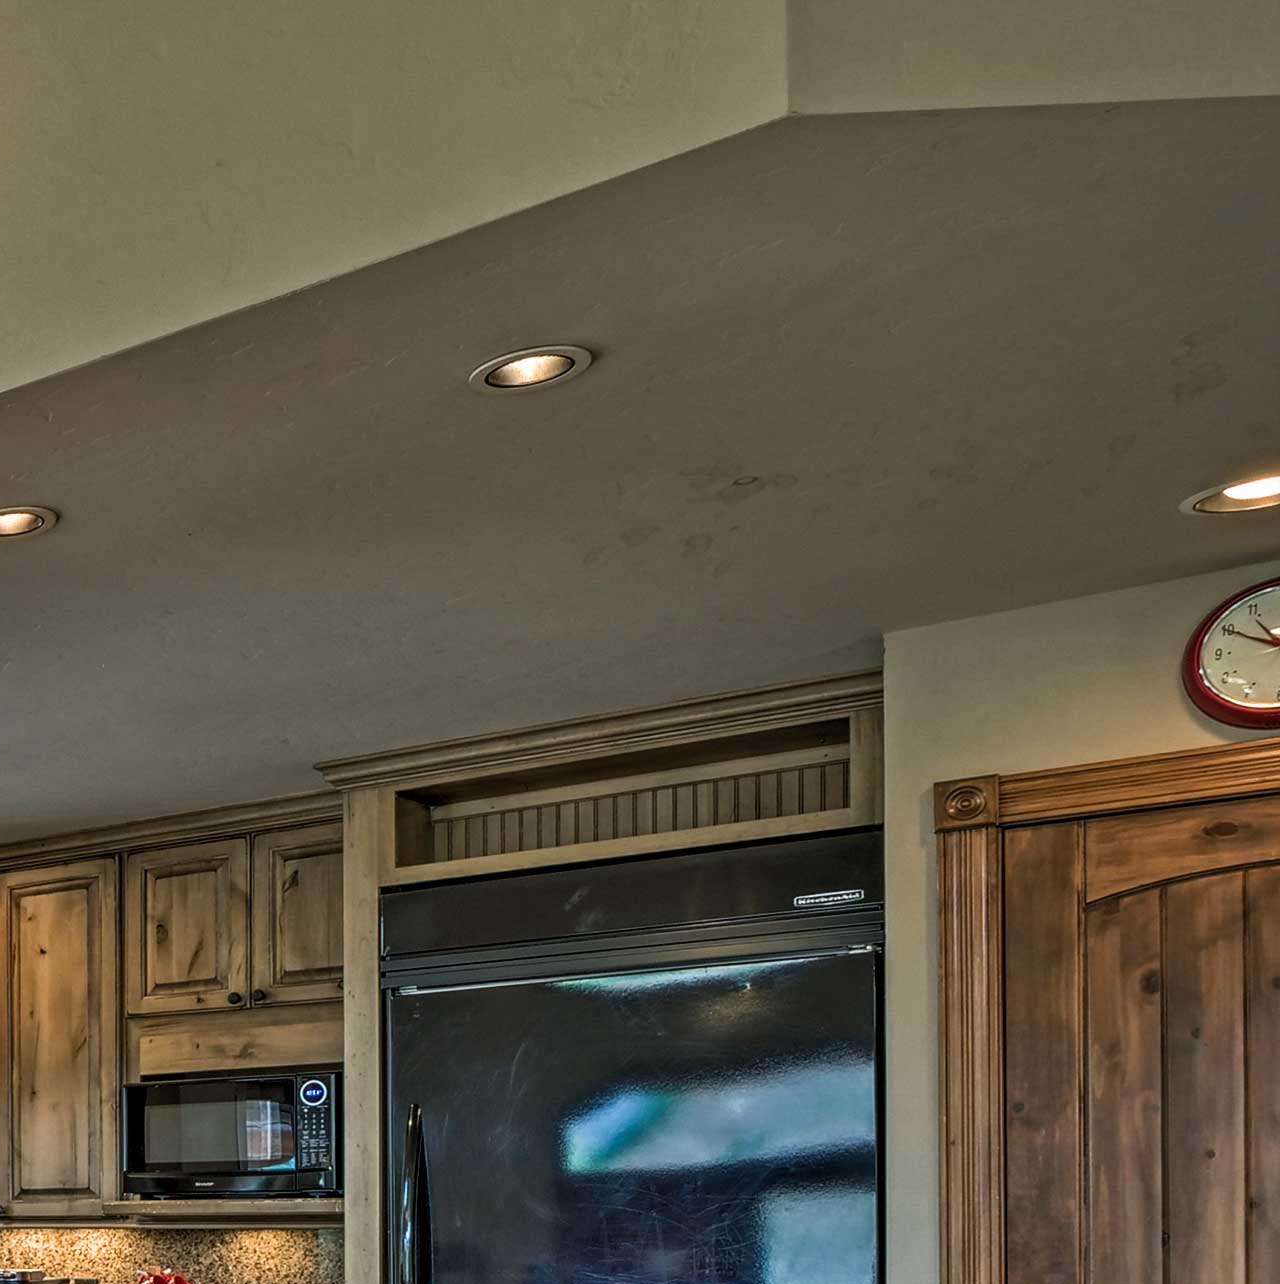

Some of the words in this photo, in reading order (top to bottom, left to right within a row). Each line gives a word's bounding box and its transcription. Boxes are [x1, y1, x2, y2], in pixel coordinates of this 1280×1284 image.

[1248, 603, 1258, 617] 11
[1221, 623, 1235, 636] 10
[1215, 648, 1223, 660] 9
